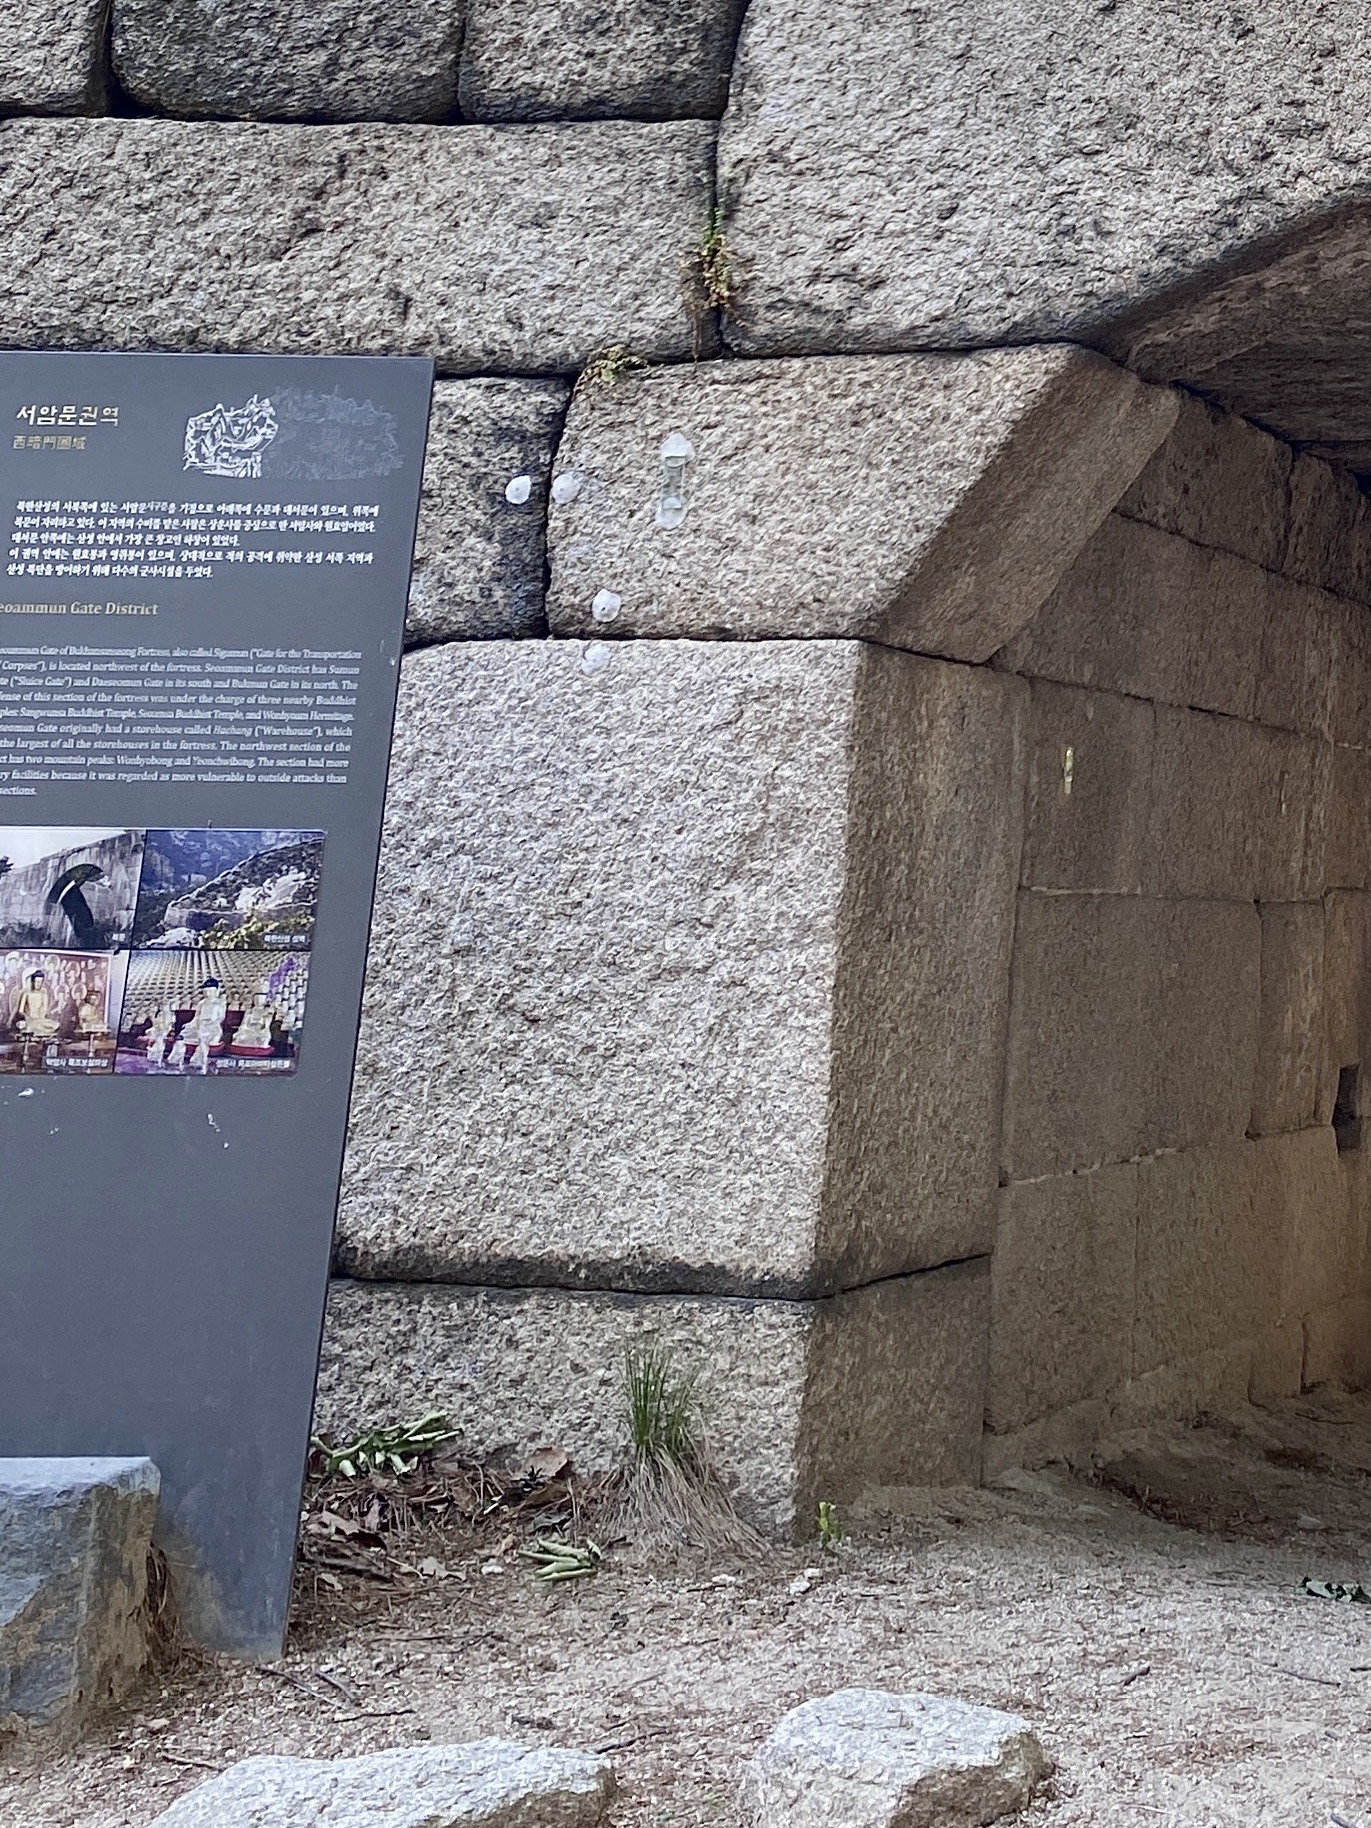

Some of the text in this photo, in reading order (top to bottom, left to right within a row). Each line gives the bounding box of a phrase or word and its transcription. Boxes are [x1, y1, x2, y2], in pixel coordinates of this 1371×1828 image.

[16, 404, 119, 427] 서암문권역
[98, 517, 107, 529] 이
[9, 547, 19, 559] 이
[71, 601, 102, 614] Gate
[105, 602, 158, 615] District
[40, 645, 59, 655] Gate
[59, 645, 69, 655] of
[275, 649, 288, 658] for
[288, 649, 301, 658] the
[49, 661, 57, 670] is
[59, 660, 91, 670] located
[92, 660, 139, 671] northwest
[140, 662, 150, 671] of
[151, 662, 165, 671] the
[256, 664, 276, 673] Gate
[277, 664, 310, 673] District
[311, 664, 327, 674] has
[73, 677, 90, 686] and
[144, 678, 164, 687] Gate
[165, 678, 174, 687] in
[175, 679, 186, 687] its
[187, 678, 212, 687] south
[213, 679, 230, 688] and
[270, 680, 289, 688] Gate
[290, 680, 299, 688] in
[301, 680, 312, 689] its
[342, 680, 358, 689] The
[23, 692, 33, 701] of
[34, 692, 51, 701] this
[52, 693, 84, 701] section
[87, 692, 97, 701] of
[98, 692, 112, 702] the
[114, 692, 149, 702] fortress
[170, 693, 197, 703] under
[199, 694, 214, 703] the
[215, 694, 245, 705] charge
[246, 694, 257, 703] of
[258, 695, 282, 704] three
[283, 695, 314, 707] nearby
[245, 710, 262, 719] and
[37, 723, 58, 732] Gate
[60, 723, 103, 736] originally
[132, 724, 182, 734] storehouse
[326, 726, 352, 736] which
[16, 738, 49, 750] largest
[51, 738, 62, 748] of
[62, 739, 74, 748] all
[76, 739, 92, 748] the
[93, 739, 149, 749] storehouses
[151, 740, 160, 749] in
[162, 740, 178, 749] the
[220, 741, 238, 750] The
[240, 741, 287, 751] northwest
[289, 742, 322, 751] section
[324, 742, 335, 751] of
[336, 742, 351, 751] the
[8, 754, 24, 763] has
[44, 755, 85, 764] mountain
[174, 756, 191, 765] and
[257, 757, 275, 766] The
[276, 758, 306, 766] section
[11, 769, 49, 779] facilities
[51, 770, 87, 780] because
[89, 771, 96, 780] it
[117, 771, 158, 782] regarded
[197, 771, 245, 781] vulnerable
[258, 772, 291, 782] outside
[292, 773, 324, 782] attacks
[327, 773, 347, 783] than
